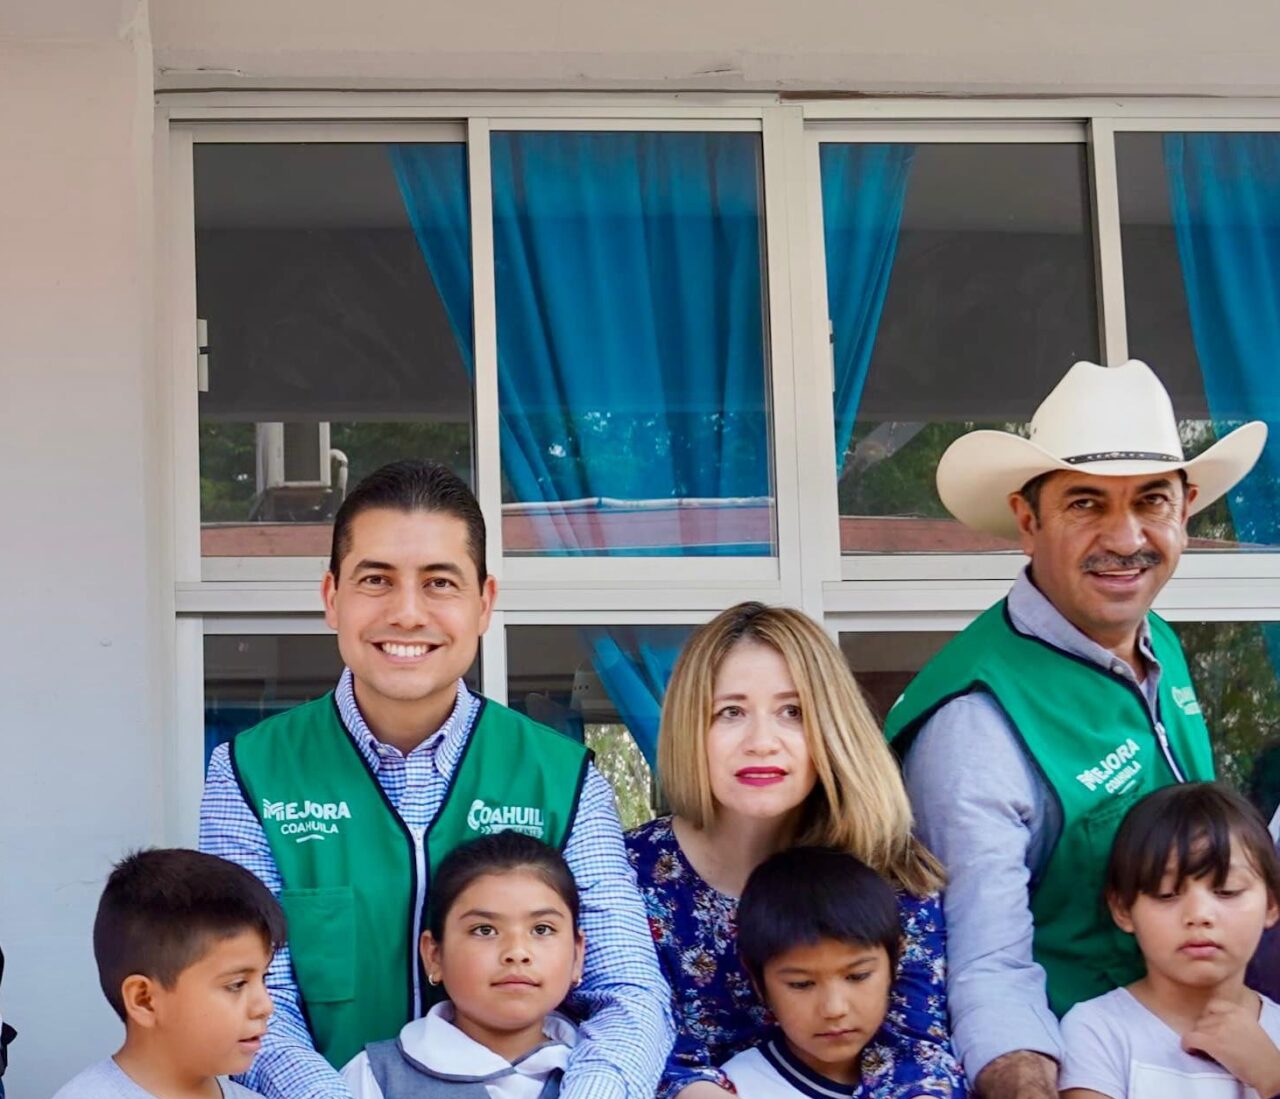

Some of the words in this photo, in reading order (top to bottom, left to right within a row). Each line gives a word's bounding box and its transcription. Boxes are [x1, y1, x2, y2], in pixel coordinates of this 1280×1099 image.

[1076, 738, 1140, 791] MEJORA
[262, 798, 352, 821] MEJORA
[467, 799, 544, 831] COAHUIL
[280, 820, 339, 835] COAHUILA
